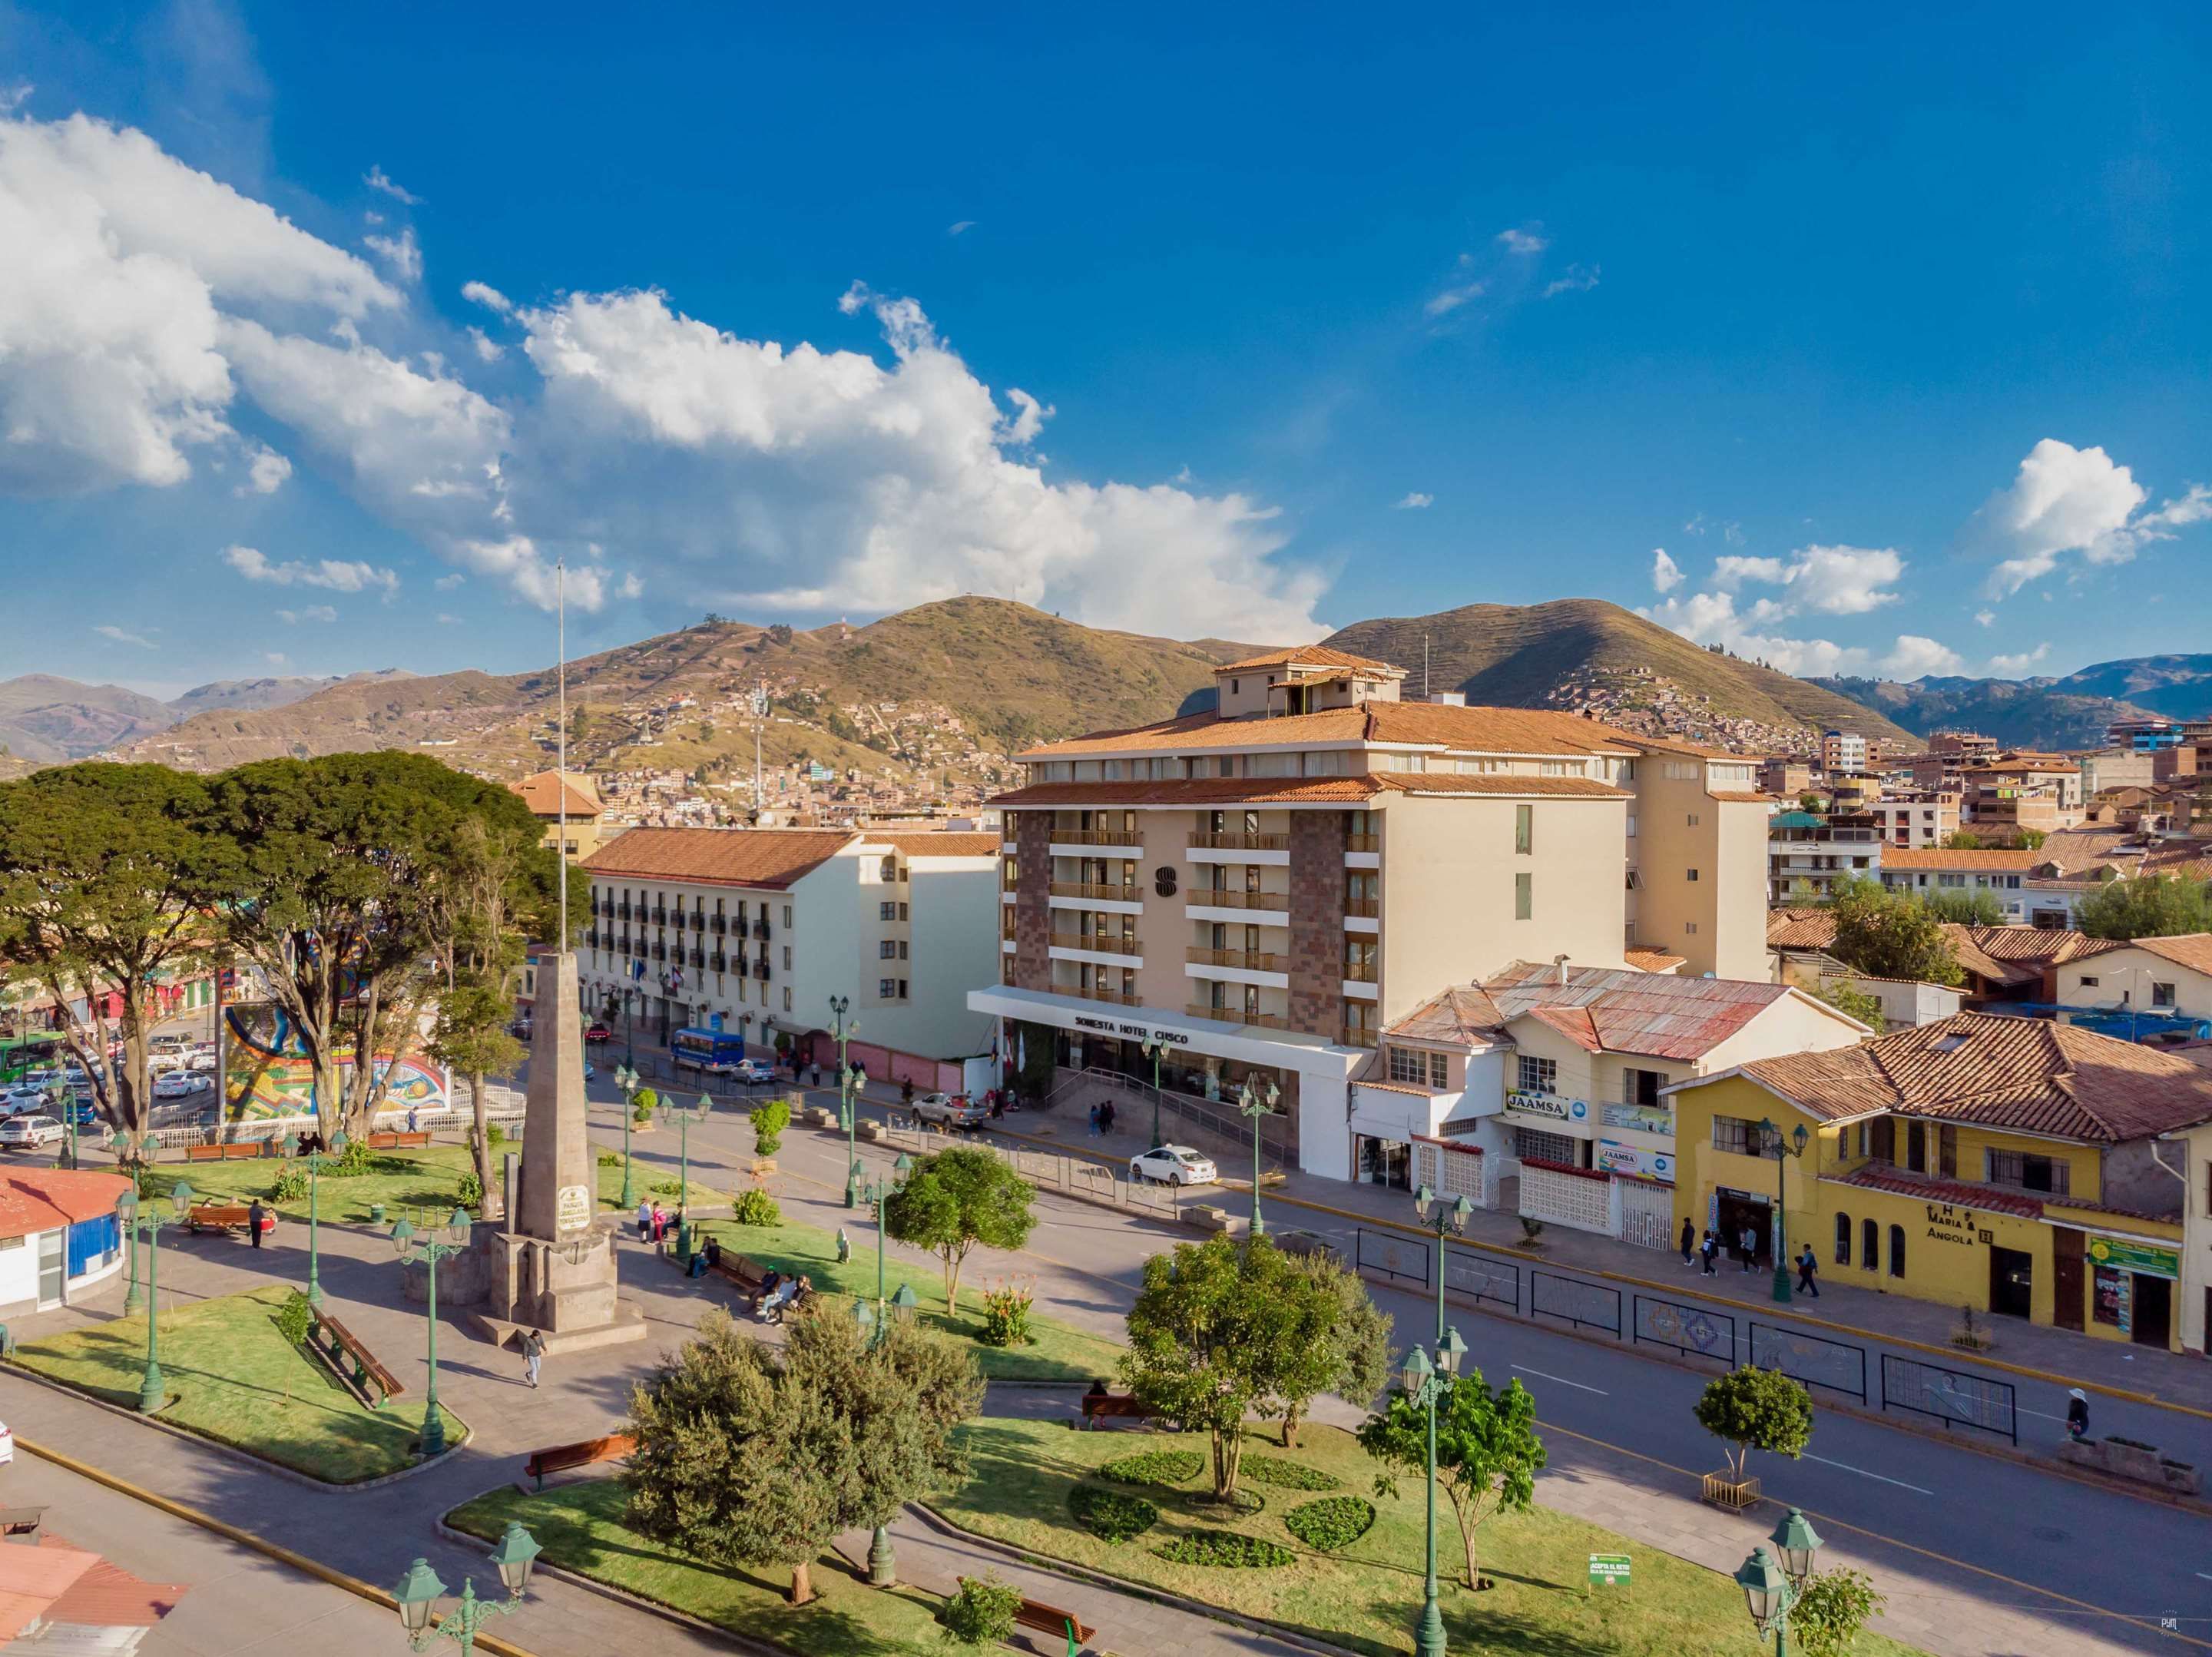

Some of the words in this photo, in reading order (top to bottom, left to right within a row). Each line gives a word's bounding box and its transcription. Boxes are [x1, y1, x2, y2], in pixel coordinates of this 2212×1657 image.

[1075, 1016, 1114, 1032] SONESTA
[1120, 1024, 1150, 1038] HOTEL
[1155, 1030, 1188, 1044] CUSCO
[1509, 1095, 1564, 1114] JAAMSA
[1604, 1151, 1634, 1163] JAAMSA
[1928, 1212, 1962, 1229] MARIA
[1926, 1226, 1973, 1246] ANGOLA
